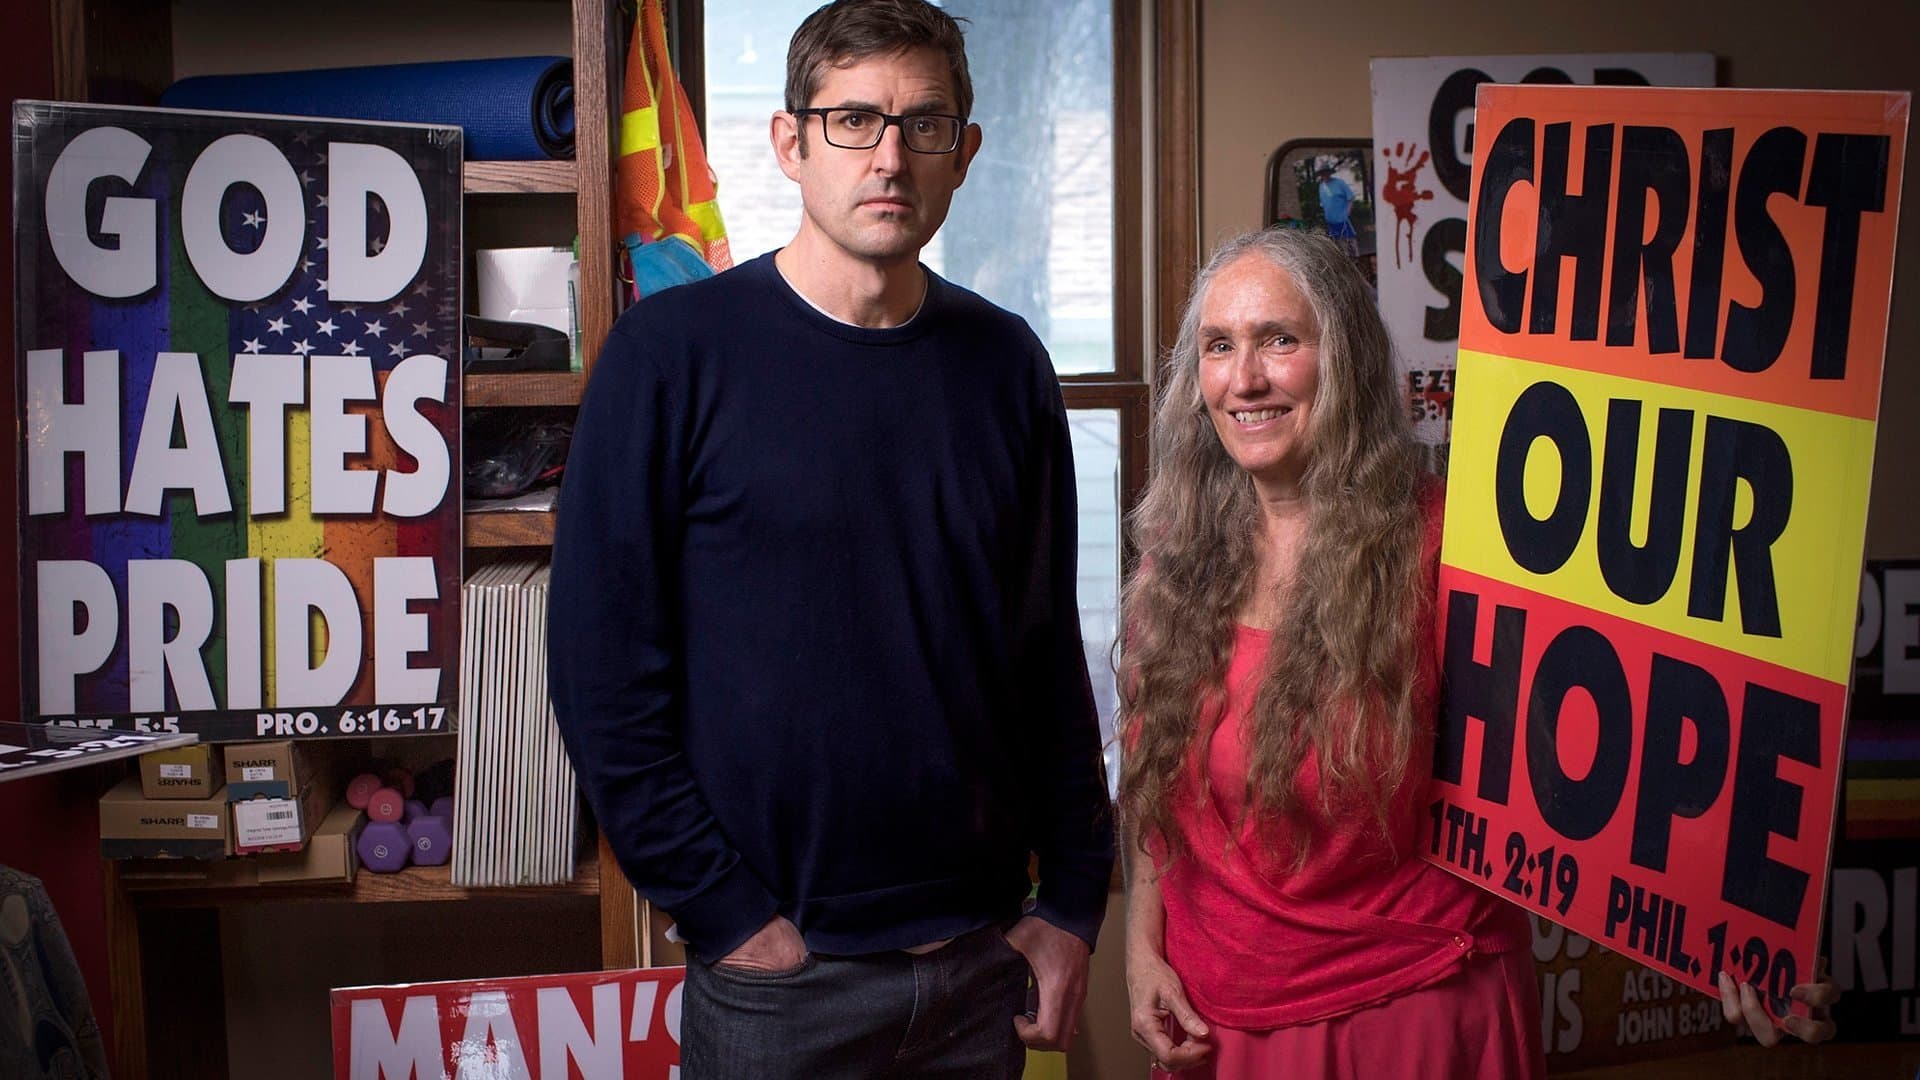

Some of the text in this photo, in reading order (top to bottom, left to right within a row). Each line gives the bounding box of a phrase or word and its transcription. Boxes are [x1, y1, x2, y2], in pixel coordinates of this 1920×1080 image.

[45, 126, 428, 302] GOD
[1474, 117, 1891, 380] CHRIST
[27, 348, 451, 517] HATES
[1496, 381, 1794, 638] OUR
[37, 556, 442, 716] PRIDE
[257, 713, 328, 736] PRO.
[339, 708, 446, 734] 6:16-17
[1432, 590, 1822, 930] HOPE
[1428, 800, 1492, 881] 1TH.
[1502, 831, 1579, 916] 2:19
[1604, 874, 1702, 979] PHIL.
[351, 979, 684, 1080] MAN'
[1616, 1000, 1722, 1048] JOHN 8:24
